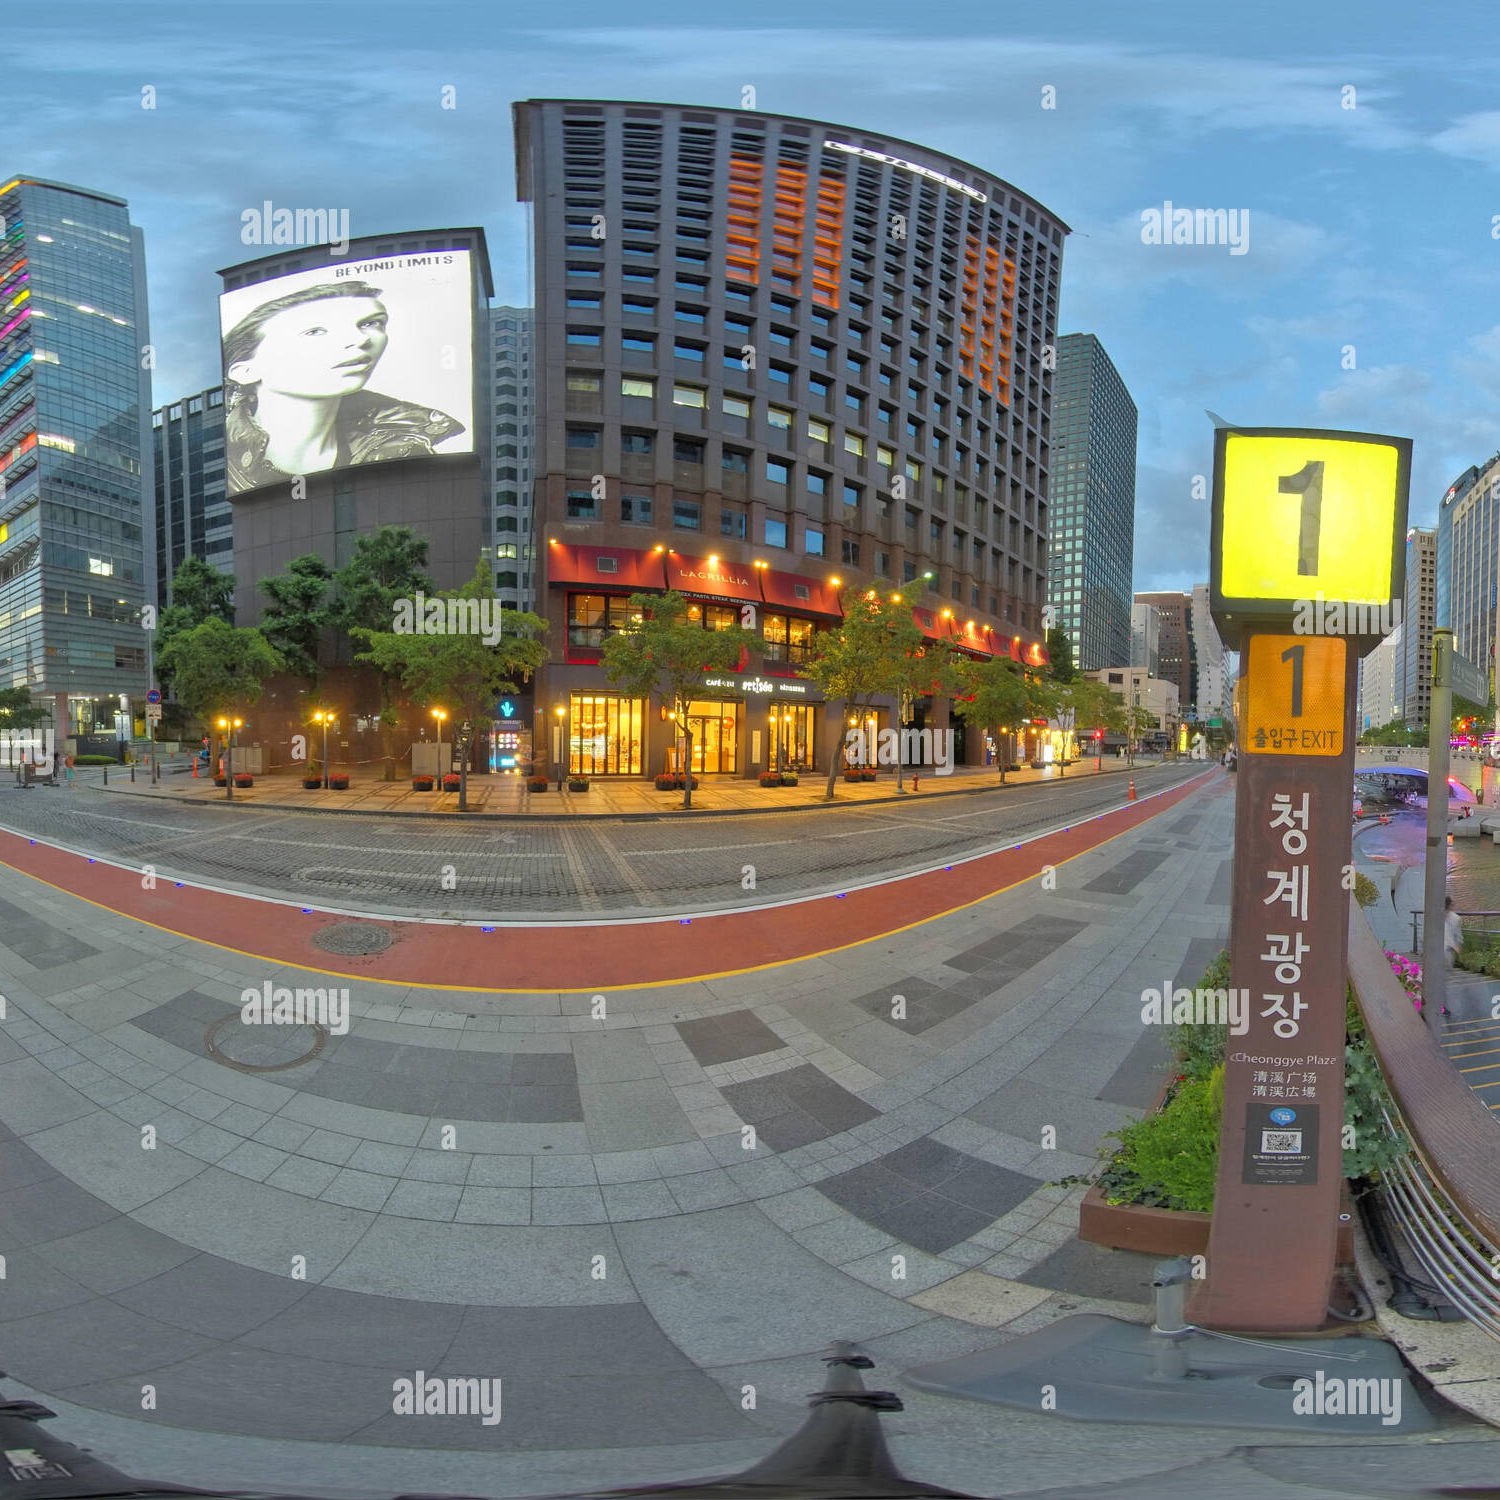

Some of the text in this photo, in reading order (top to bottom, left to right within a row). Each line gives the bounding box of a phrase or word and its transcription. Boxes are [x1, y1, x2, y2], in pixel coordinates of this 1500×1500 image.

[335, 256, 453, 278] BEYOND LIMITS
[1278, 461, 1325, 576] 1
[680, 569, 749, 586] LAGRILLIA
[1281, 645, 1305, 717] 1
[1251, 727, 1338, 749] 출입구 EXIT
[1260, 792, 1311, 1039] 청계광장
